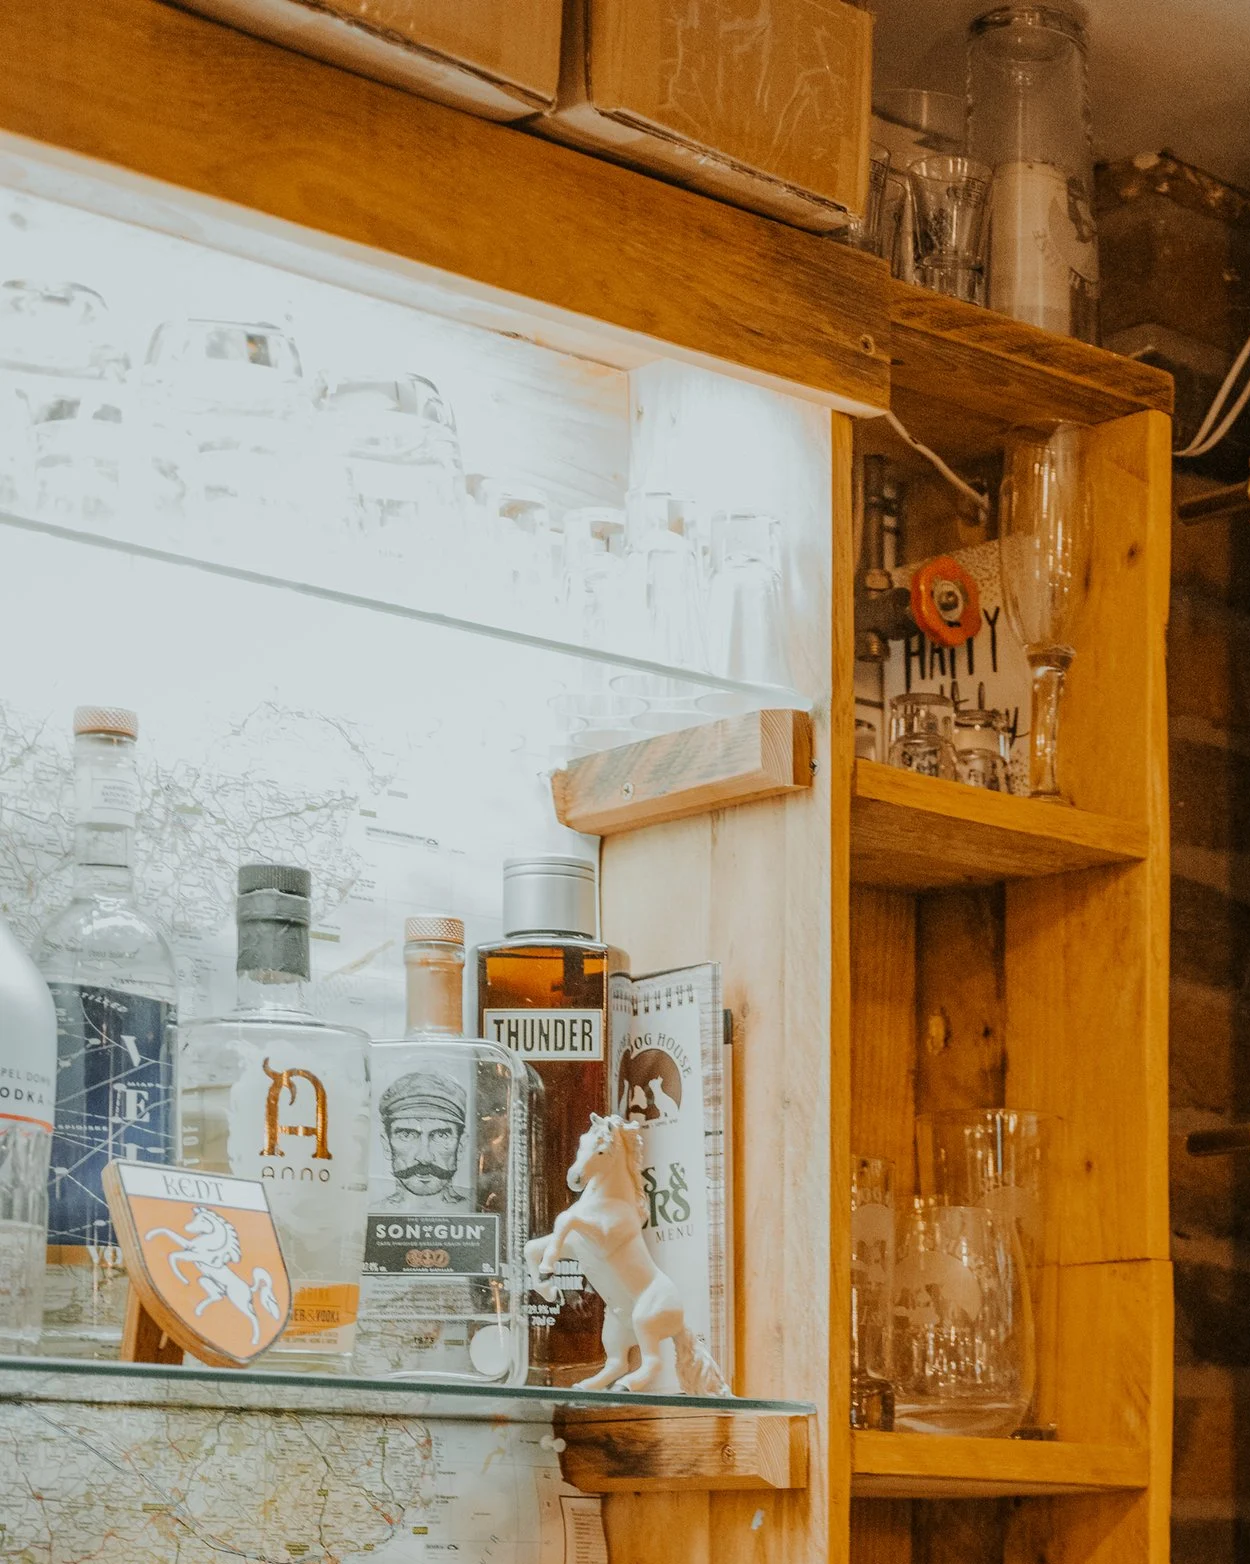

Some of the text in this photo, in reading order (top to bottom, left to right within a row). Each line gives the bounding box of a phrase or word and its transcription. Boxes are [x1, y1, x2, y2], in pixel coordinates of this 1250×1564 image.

[492, 1017, 595, 1052] THUNDER
[657, 1032, 692, 1079] HOUSE
[0, 1087, 45, 1105] ODKA
[162, 1174, 224, 1202] KENT
[375, 1223, 482, 1240] SON GUN
[656, 1223, 695, 1244] MENU
